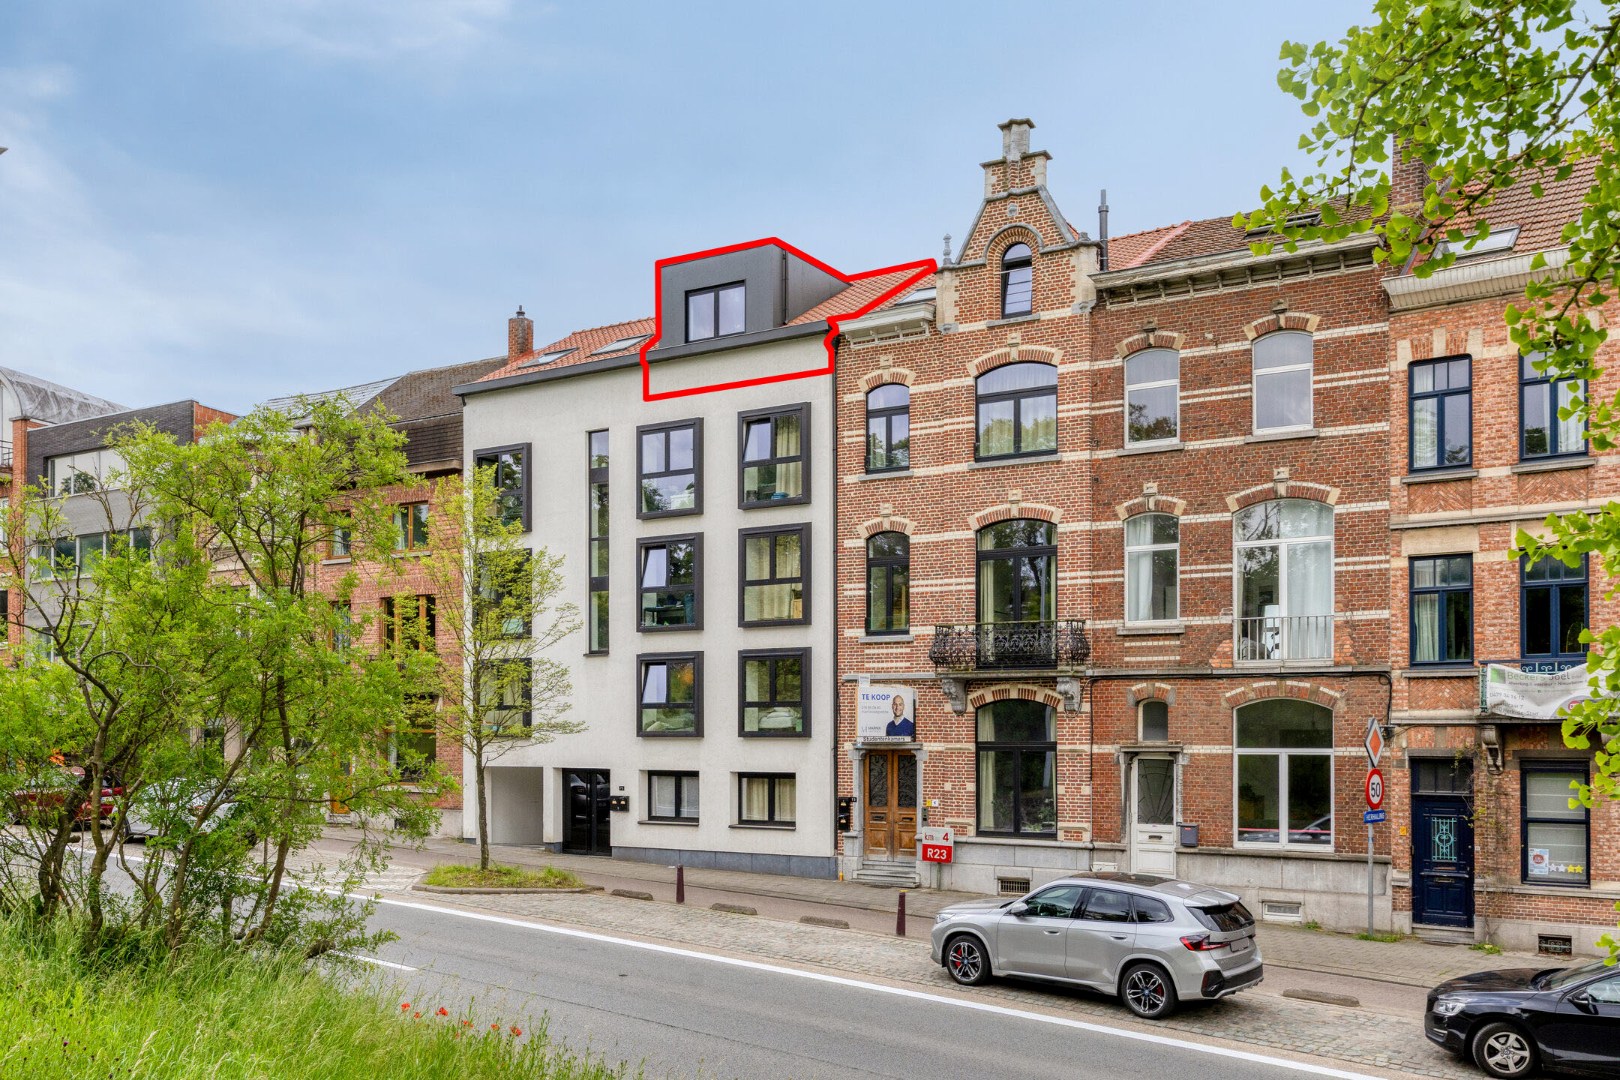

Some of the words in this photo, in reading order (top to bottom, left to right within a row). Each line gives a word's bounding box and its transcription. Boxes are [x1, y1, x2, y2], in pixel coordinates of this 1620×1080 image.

[861, 693, 870, 701] TE
[871, 693, 891, 701] KOOP
[1371, 783, 1380, 797] 50
[924, 832, 934, 840] km
[942, 832, 949, 842] 4
[927, 848, 947, 860] R23
